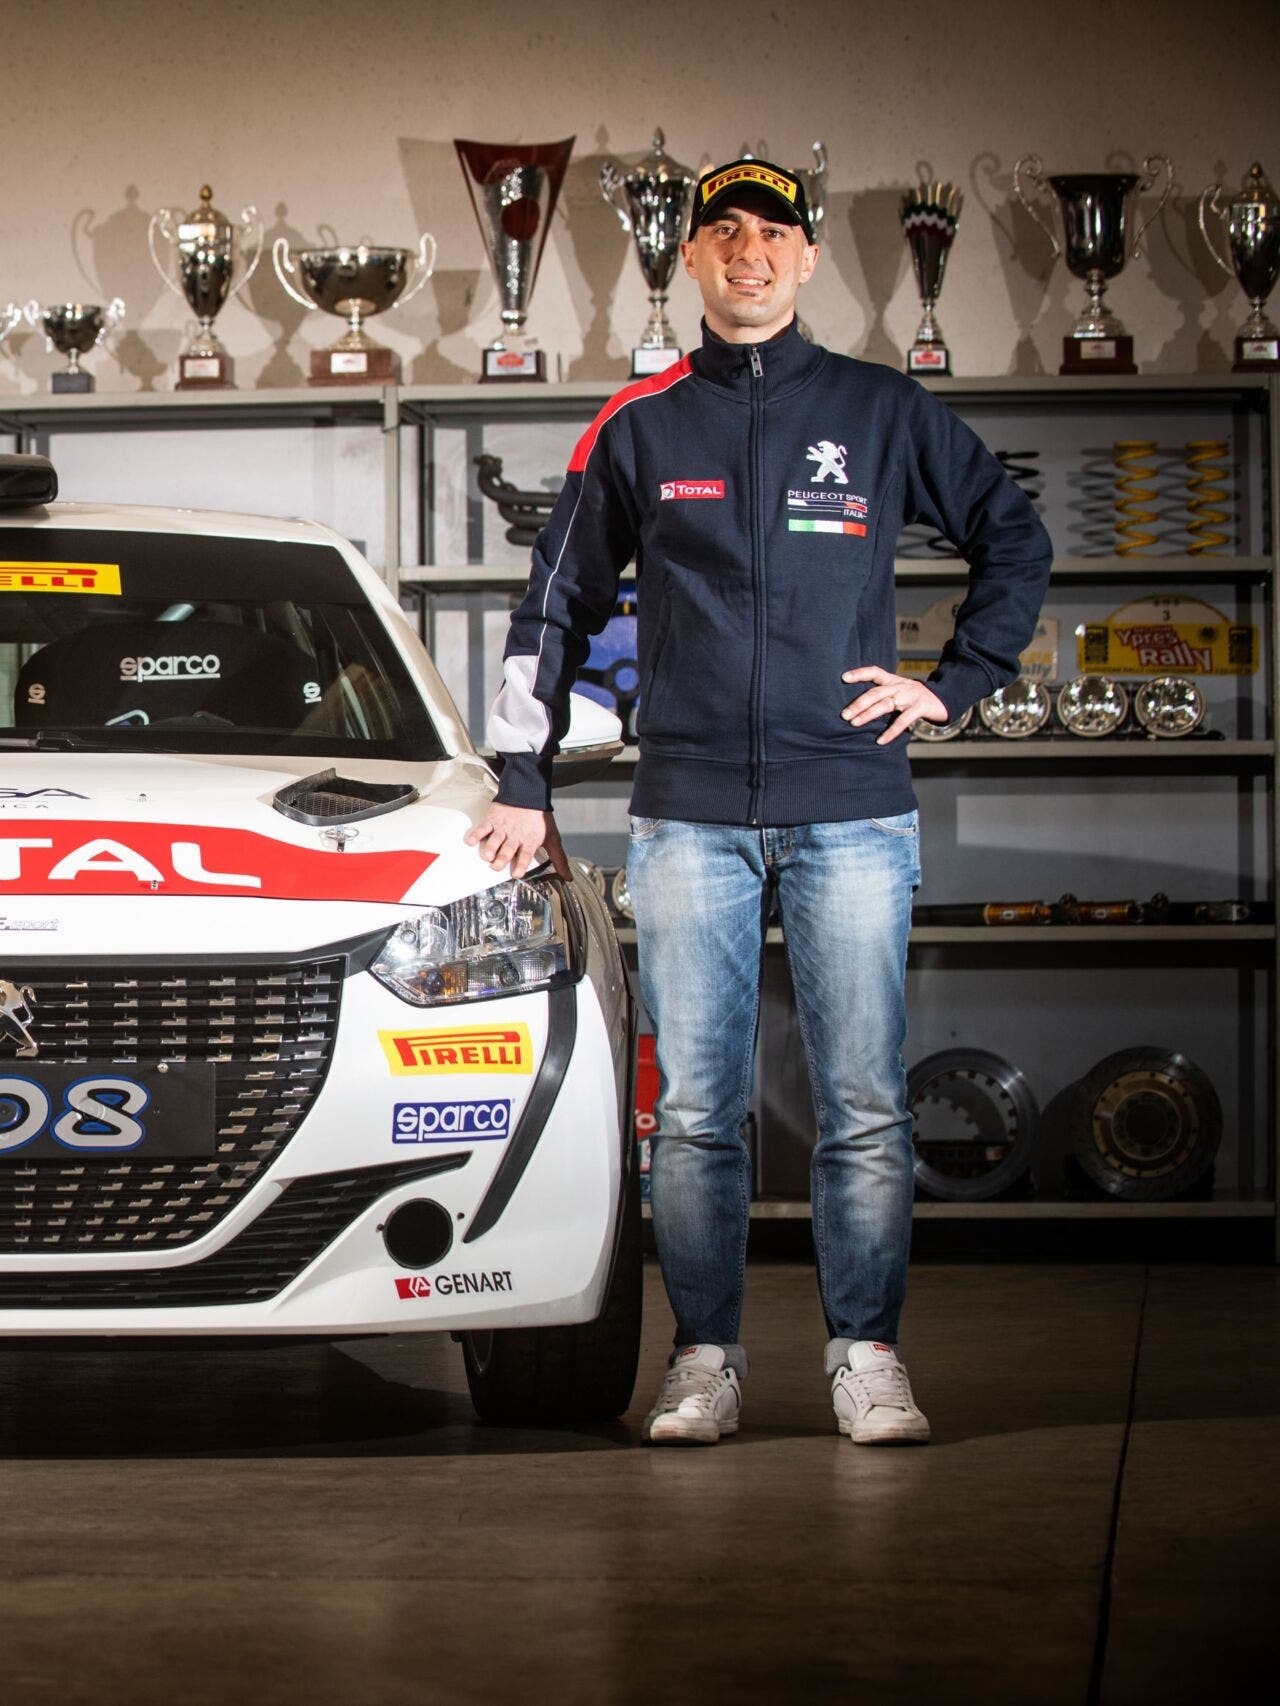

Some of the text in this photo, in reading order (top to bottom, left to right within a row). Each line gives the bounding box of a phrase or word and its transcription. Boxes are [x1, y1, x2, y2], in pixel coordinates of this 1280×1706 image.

[708, 167, 790, 194] PIRELLI
[787, 489, 867, 504] PEUGEOT SPORT
[1117, 628, 1178, 648] Ypres
[119, 654, 221, 682] sparco
[1140, 643, 1211, 672] Rally
[392, 1031, 521, 1066] PIRELLI
[396, 1103, 508, 1141] sparco
[435, 1271, 513, 1295] GENART
